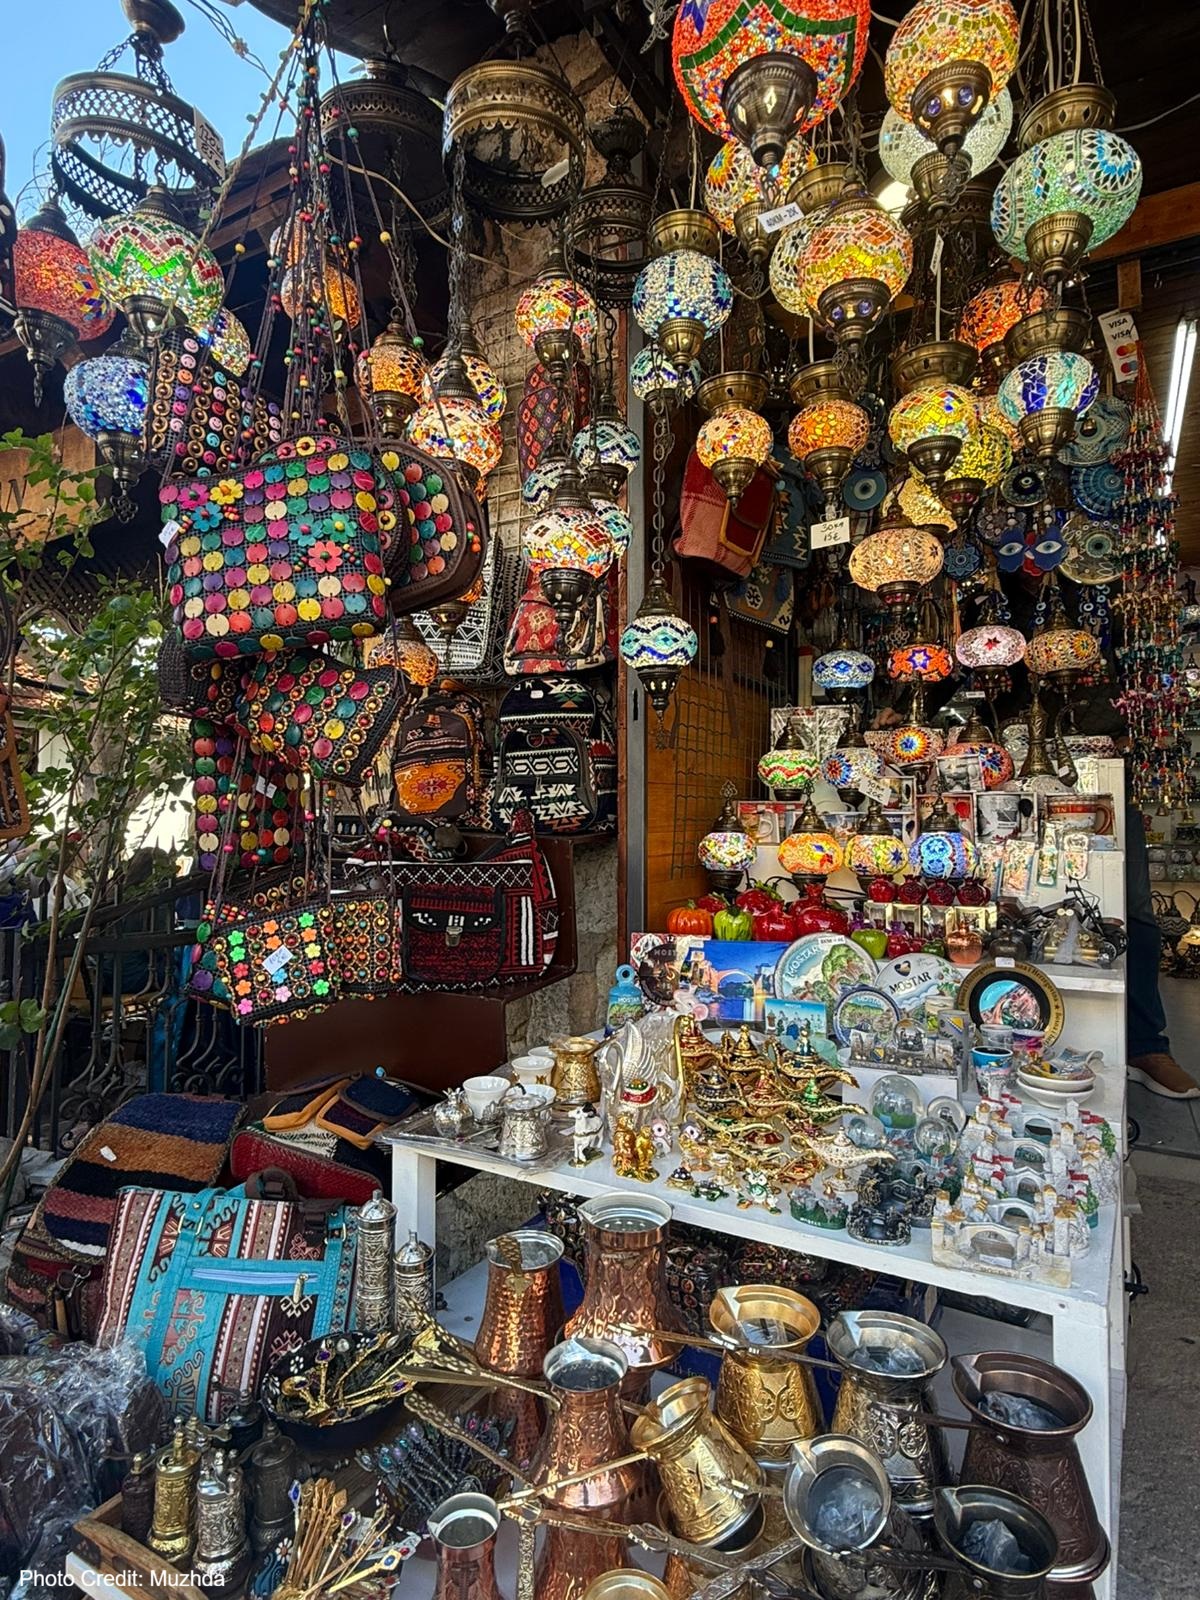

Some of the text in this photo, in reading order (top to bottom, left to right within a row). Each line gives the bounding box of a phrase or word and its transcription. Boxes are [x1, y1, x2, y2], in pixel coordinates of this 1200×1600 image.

[1109, 318, 1128, 329] VISA
[1112, 329, 1132, 340] VISA
[783, 944, 822, 979] MOSTAR
[889, 971, 932, 995] MOSTAR
